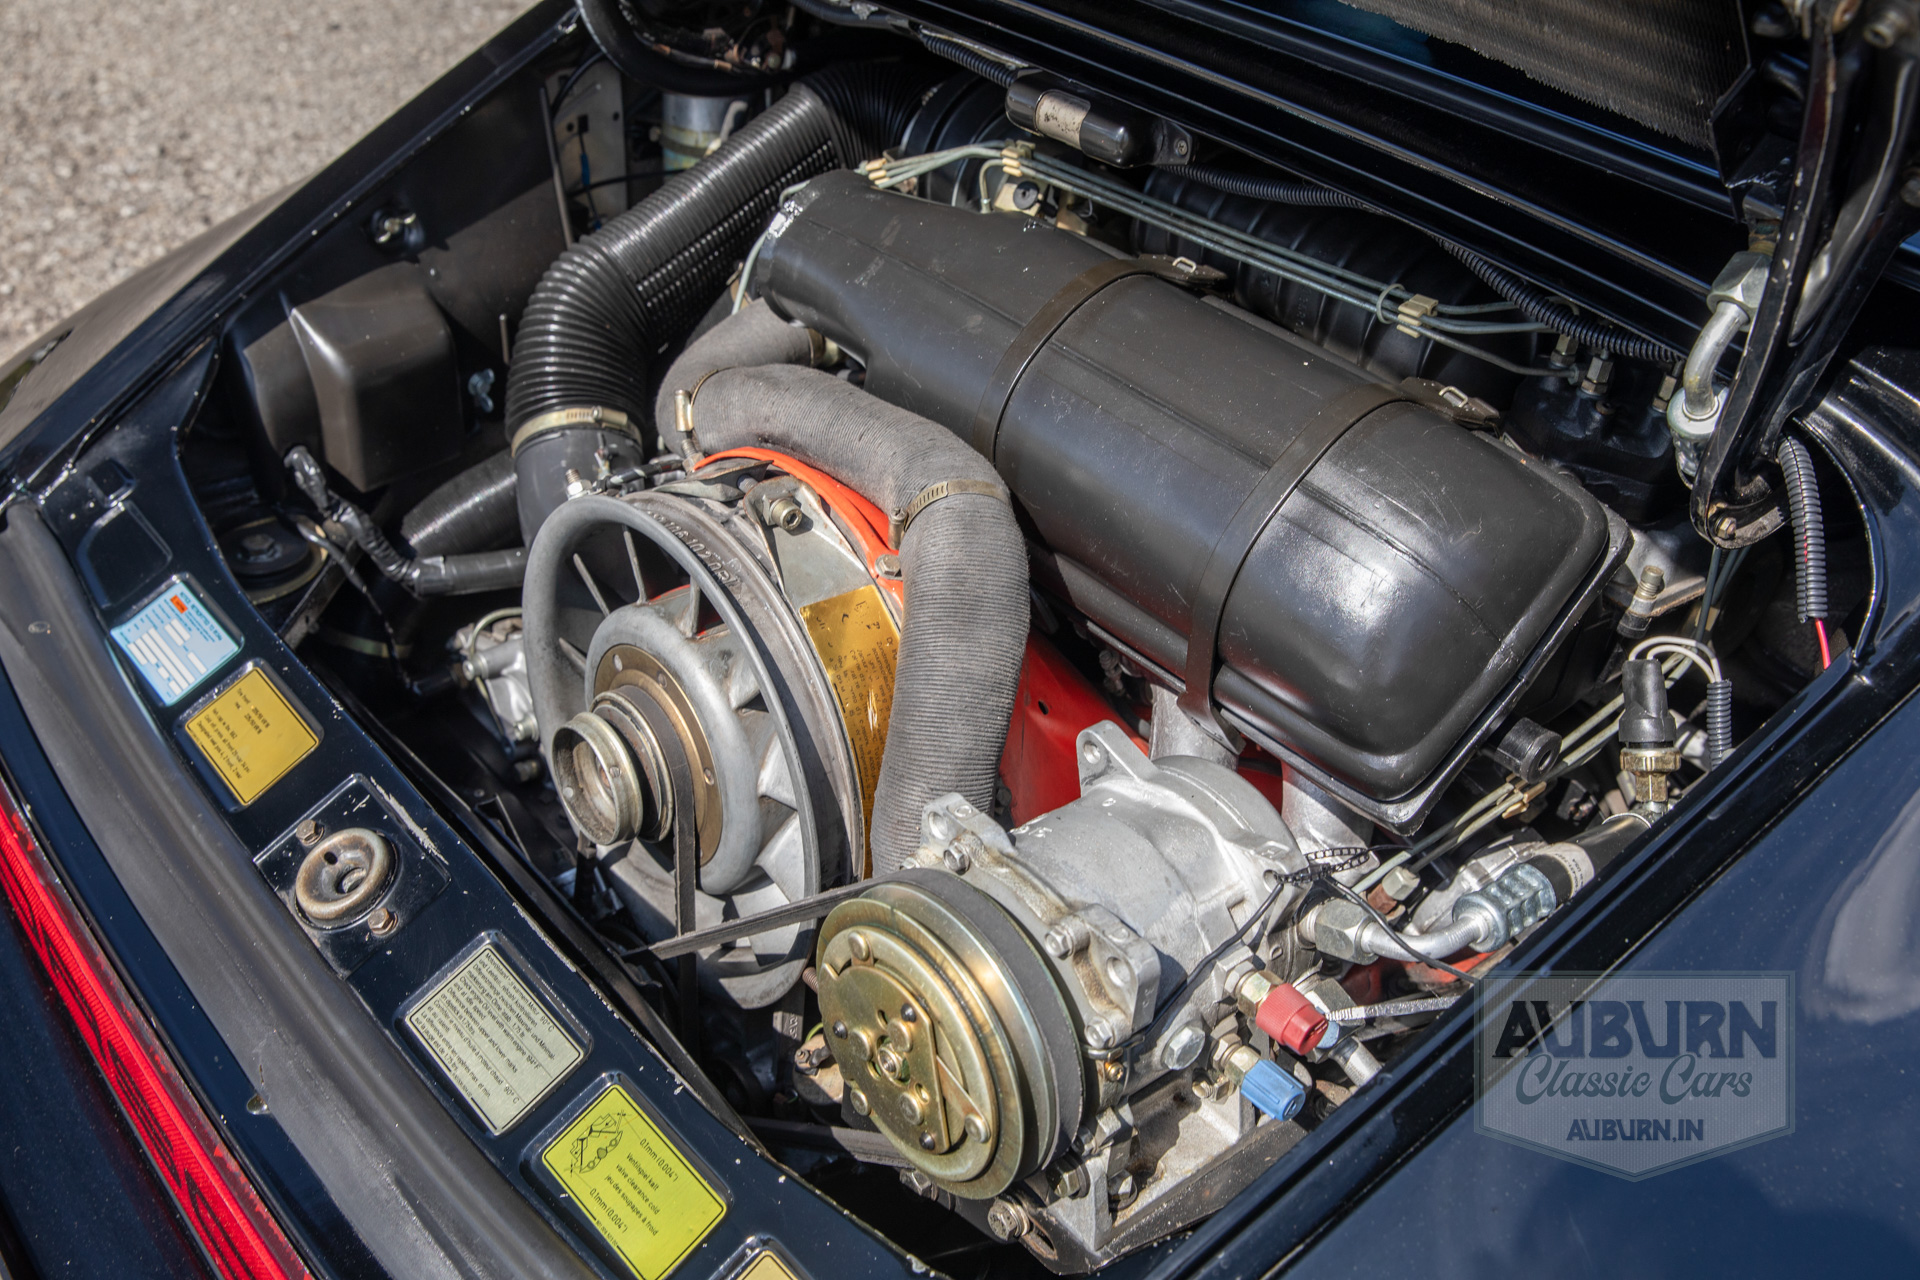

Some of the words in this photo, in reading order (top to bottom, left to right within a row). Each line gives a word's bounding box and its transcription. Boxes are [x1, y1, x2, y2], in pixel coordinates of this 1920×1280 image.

[446, 986, 466, 1010] Difference
[462, 1006, 481, 1027] between
[476, 1024, 490, 1040] upper
[487, 1036, 498, 1048] and
[458, 975, 472, 991] Check
[468, 988, 484, 1006] engine
[614, 1162, 630, 1179] valve
[626, 1175, 651, 1204] clearance
[647, 1200, 660, 1215] cold
[624, 1152, 651, 1182] Ventilspiel
[647, 1177, 659, 1191] kalt
[604, 1173, 616, 1186] jeu
[611, 1180, 624, 1194] des
[618, 1191, 643, 1220] soupapes
[644, 1220, 659, 1236] froid
